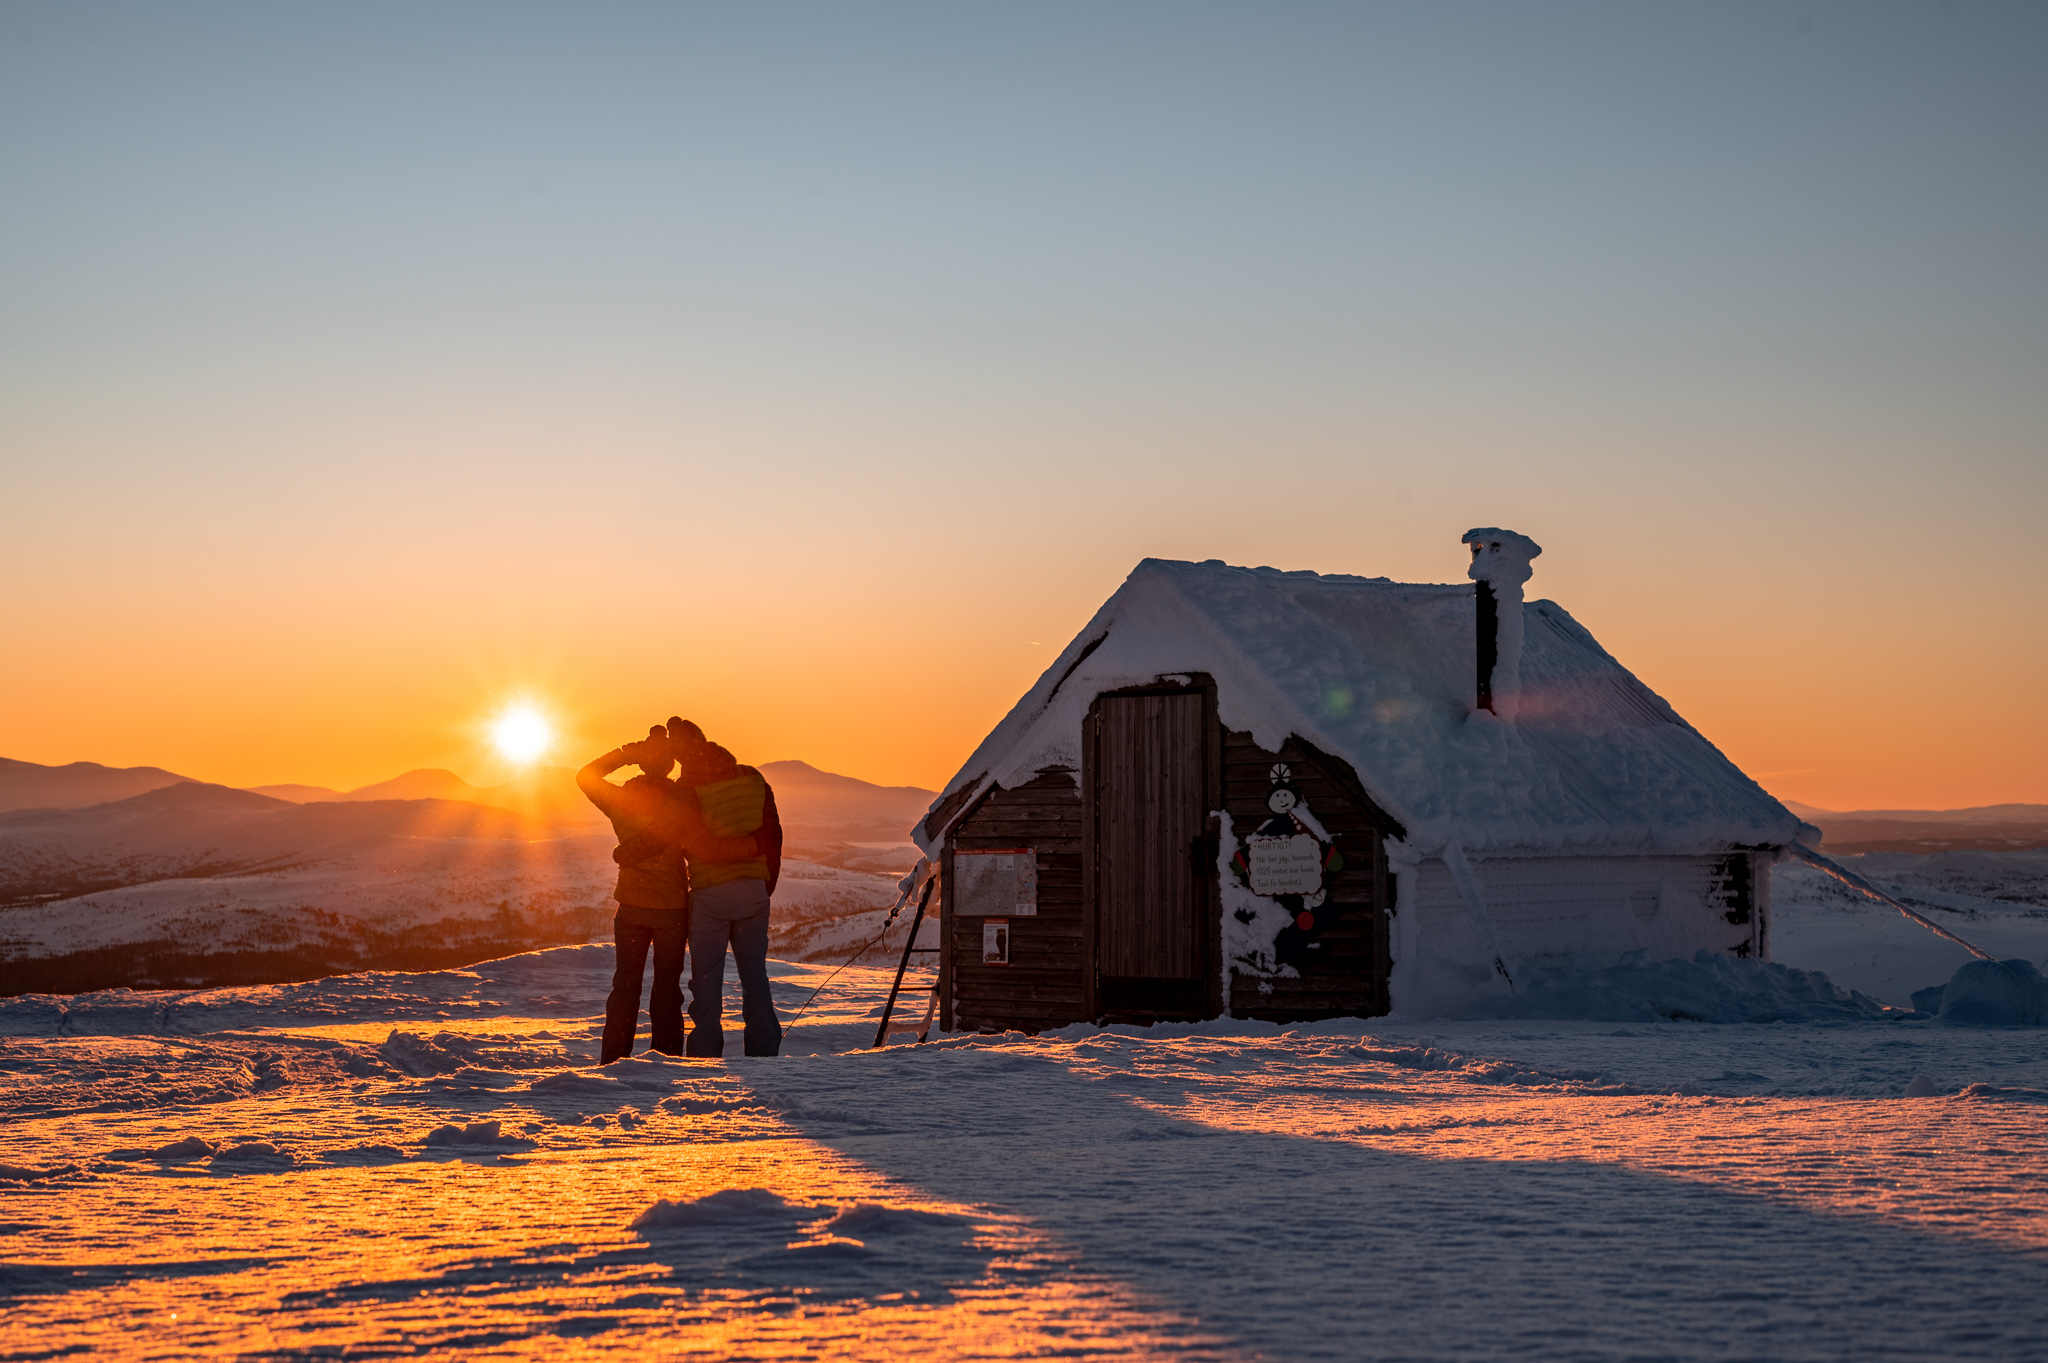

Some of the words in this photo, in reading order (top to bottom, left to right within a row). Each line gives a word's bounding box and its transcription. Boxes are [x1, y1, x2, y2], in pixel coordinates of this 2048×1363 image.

[1257, 841, 1292, 851] HURTIGT!
[1268, 854, 1277, 863] bor
[1256, 866, 1271, 875] 1025
[1257, 879, 1269, 887] Tack
[1270, 878, 1278, 887] för
